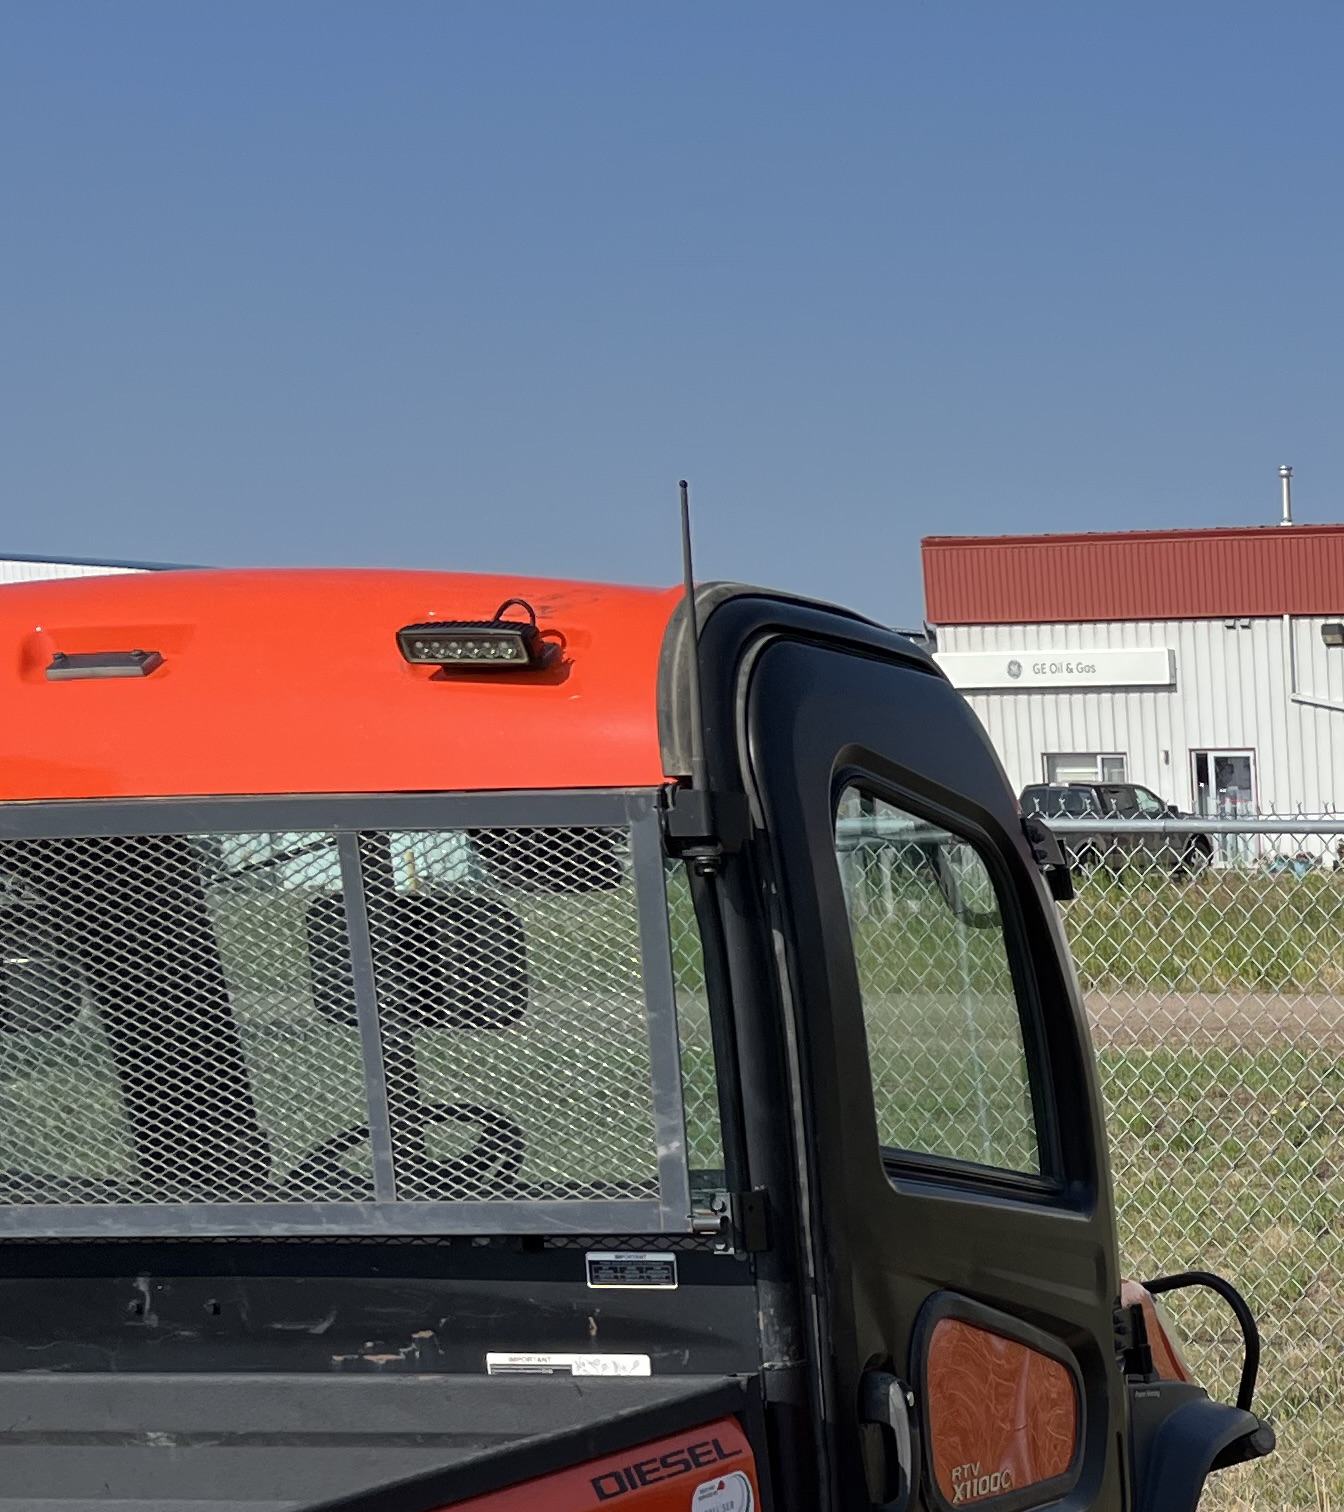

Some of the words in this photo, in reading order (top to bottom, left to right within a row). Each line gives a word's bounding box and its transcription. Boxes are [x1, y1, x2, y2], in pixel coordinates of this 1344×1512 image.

[1032, 662, 1047, 674] GE
[1049, 662, 1063, 674] Oil
[1066, 662, 1074, 673] &
[1076, 662, 1096, 674] Gas
[589, 1438, 743, 1502] DIESEL
[952, 1461, 981, 1483] RTV
[952, 1468, 1013, 1504] X1100C
